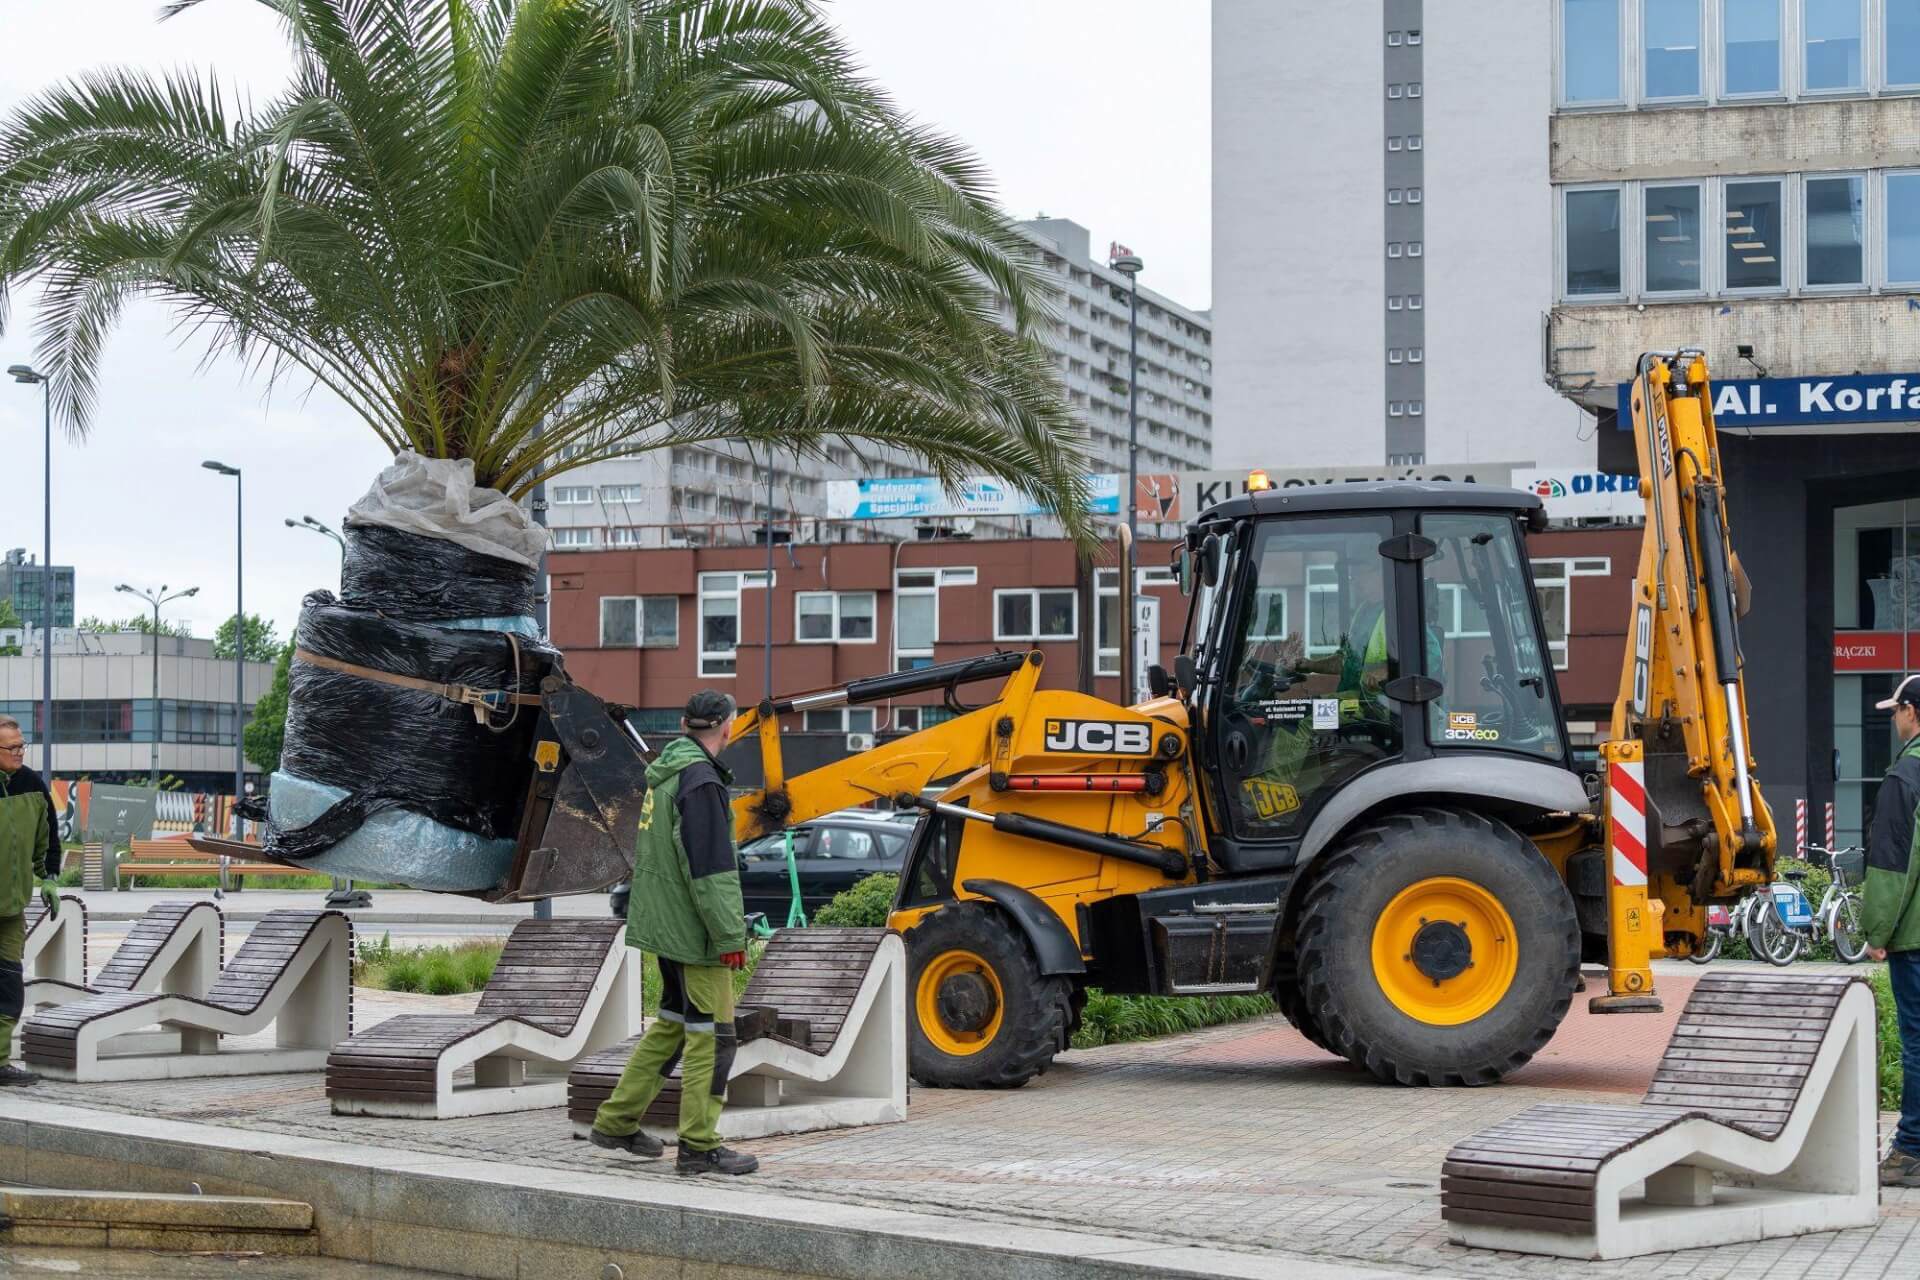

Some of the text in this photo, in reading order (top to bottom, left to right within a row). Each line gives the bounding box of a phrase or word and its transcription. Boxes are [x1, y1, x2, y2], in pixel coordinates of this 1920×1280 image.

[1713, 385, 1777, 416] Al.
[1833, 645, 1876, 659] RĄCZKI
[1452, 715, 1474, 724] JCB
[1046, 721, 1150, 753] JCB
[1445, 729, 1499, 740] 3CXeco
[1255, 782, 1298, 816] JCB
